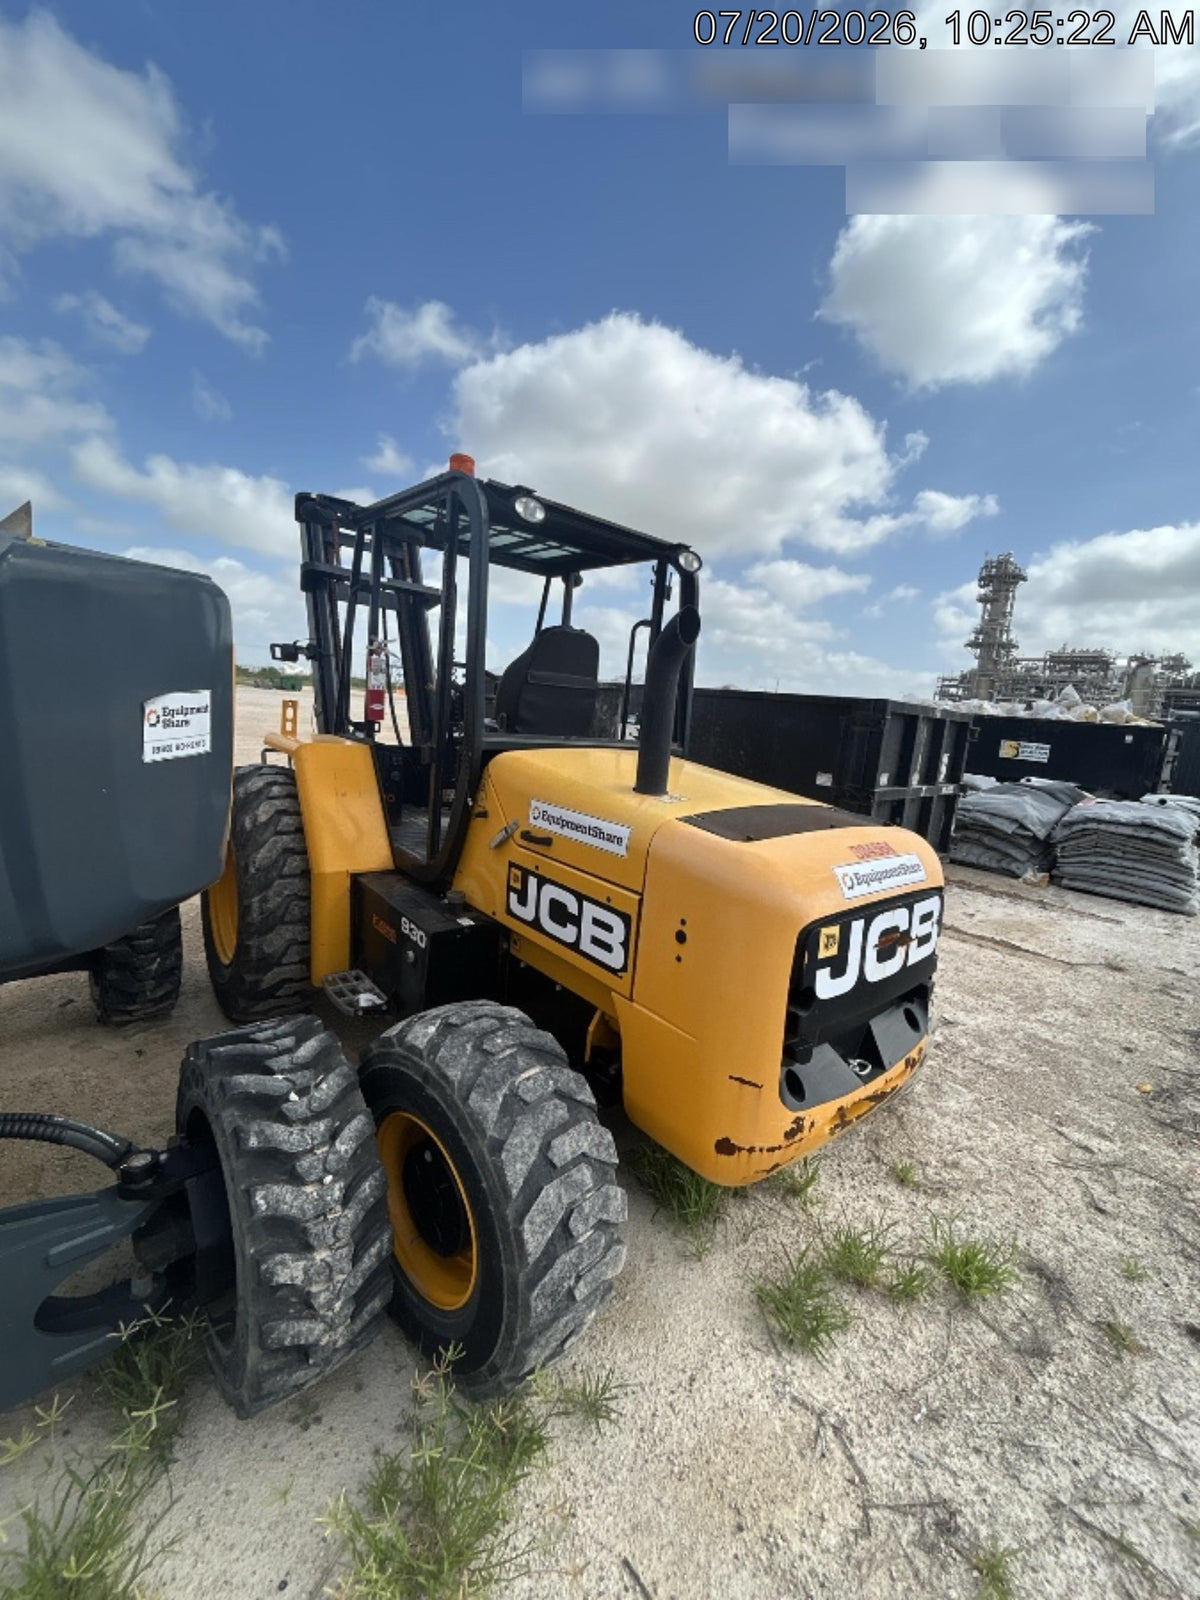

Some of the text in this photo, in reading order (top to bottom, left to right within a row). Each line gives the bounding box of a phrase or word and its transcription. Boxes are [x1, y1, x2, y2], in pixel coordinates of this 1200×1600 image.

[541, 810, 623, 847] EquipmentShare
[401, 916, 427, 948] 930
[509, 875, 626, 970] JCB
[815, 896, 941, 1000] JCB
